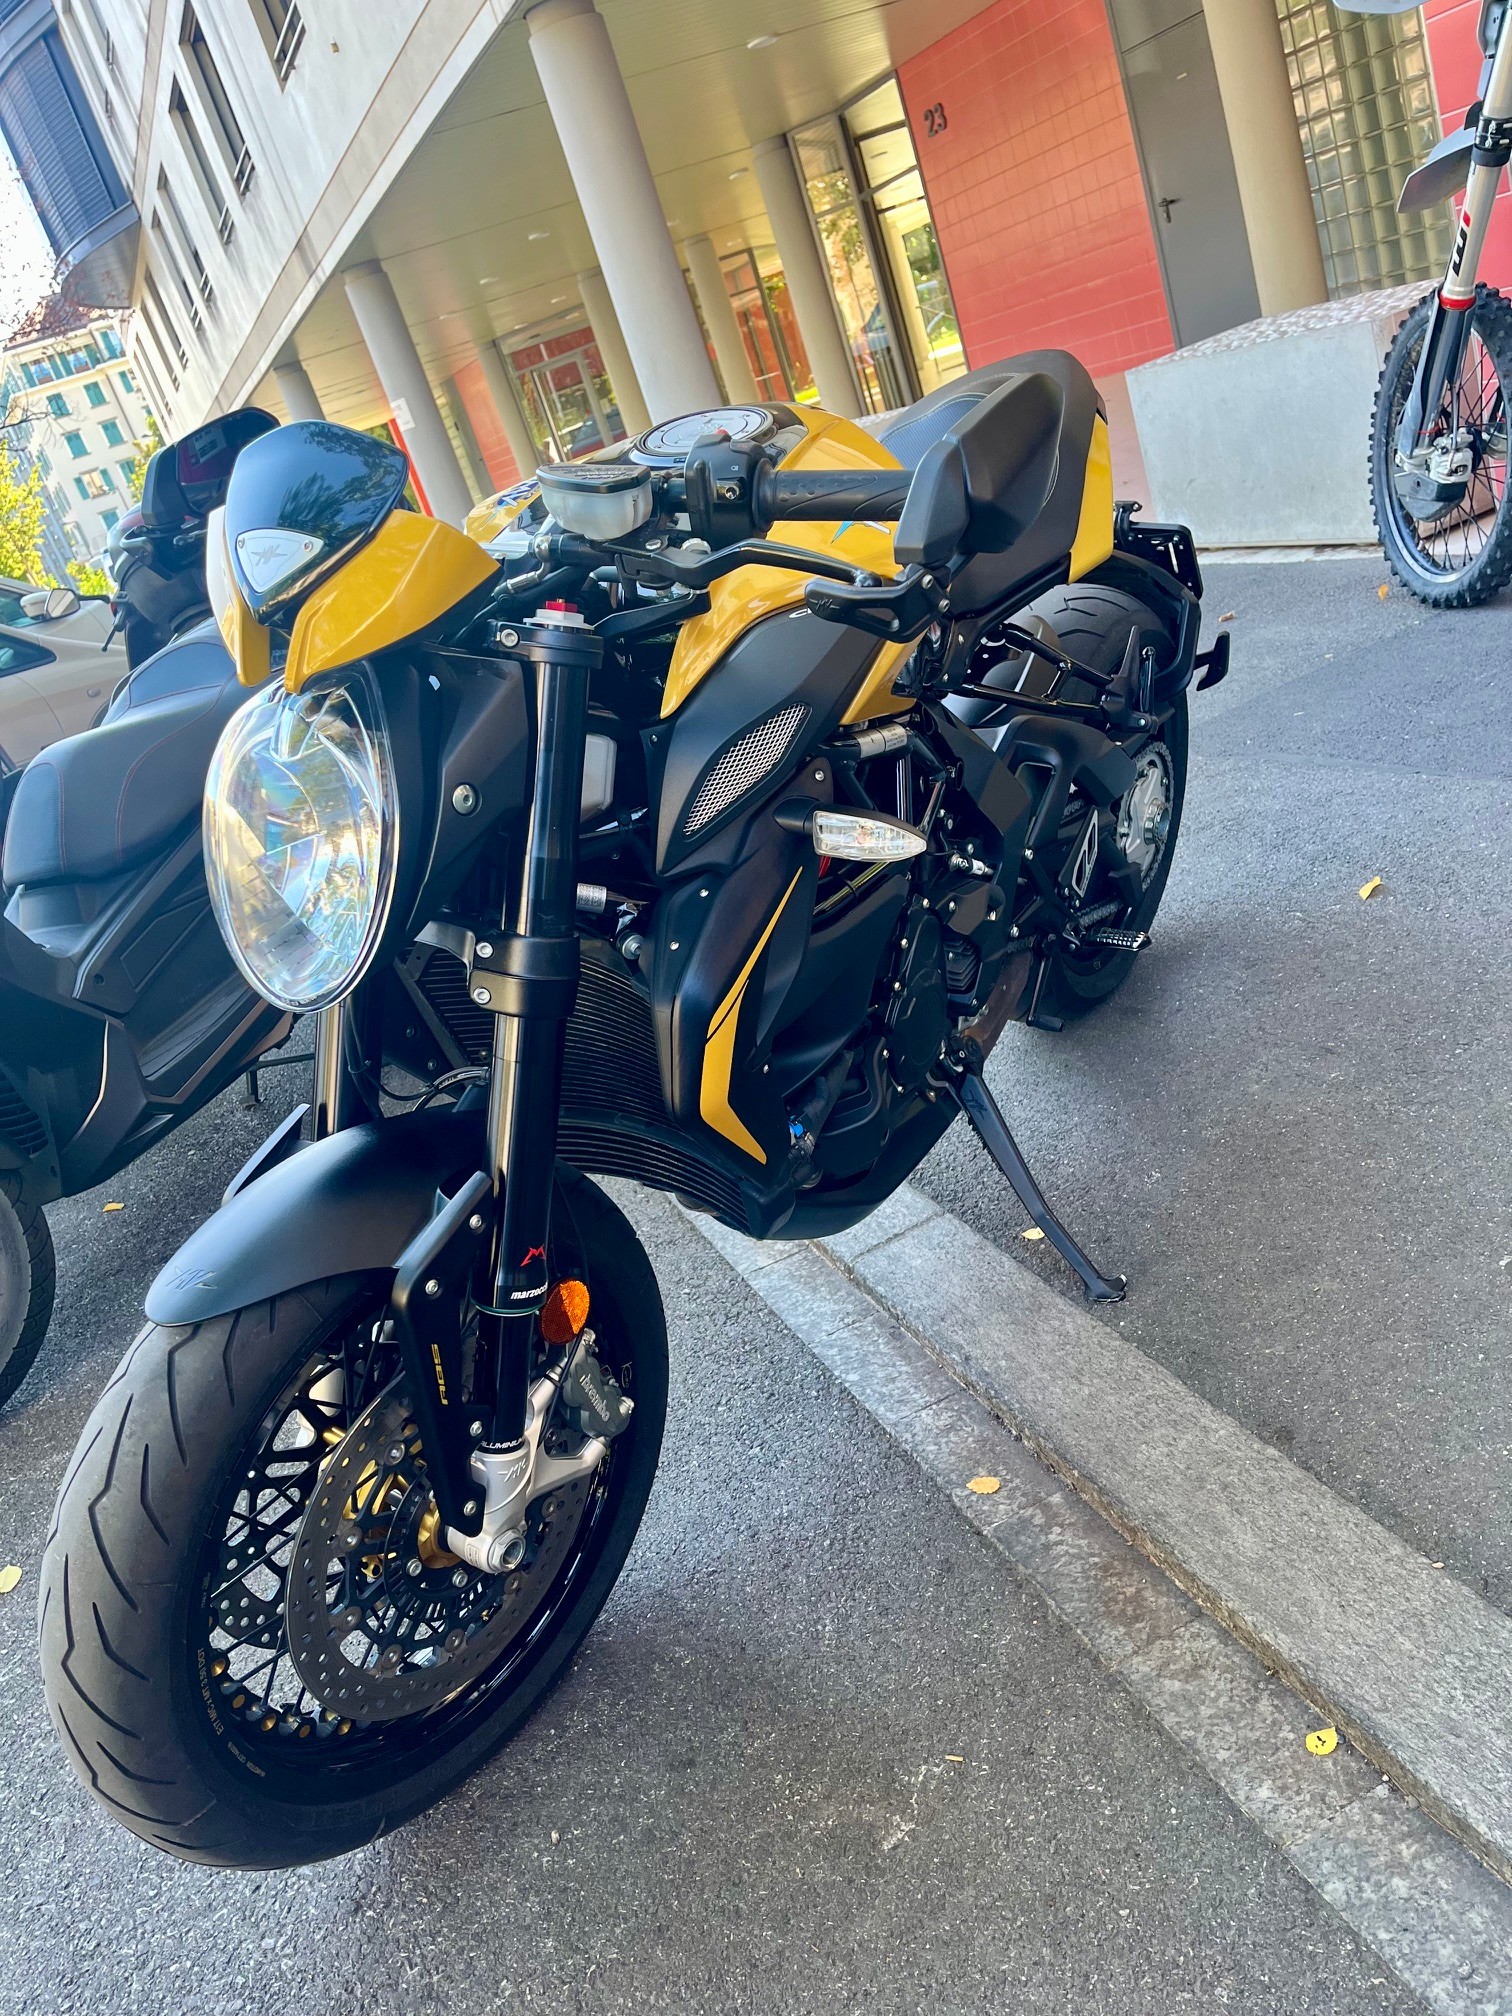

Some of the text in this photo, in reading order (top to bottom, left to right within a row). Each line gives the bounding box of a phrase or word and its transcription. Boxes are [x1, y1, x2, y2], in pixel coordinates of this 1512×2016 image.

[923, 102, 947, 139] 23
[431, 1344, 448, 1405] ABS
[580, 1373, 611, 1422] brembo
